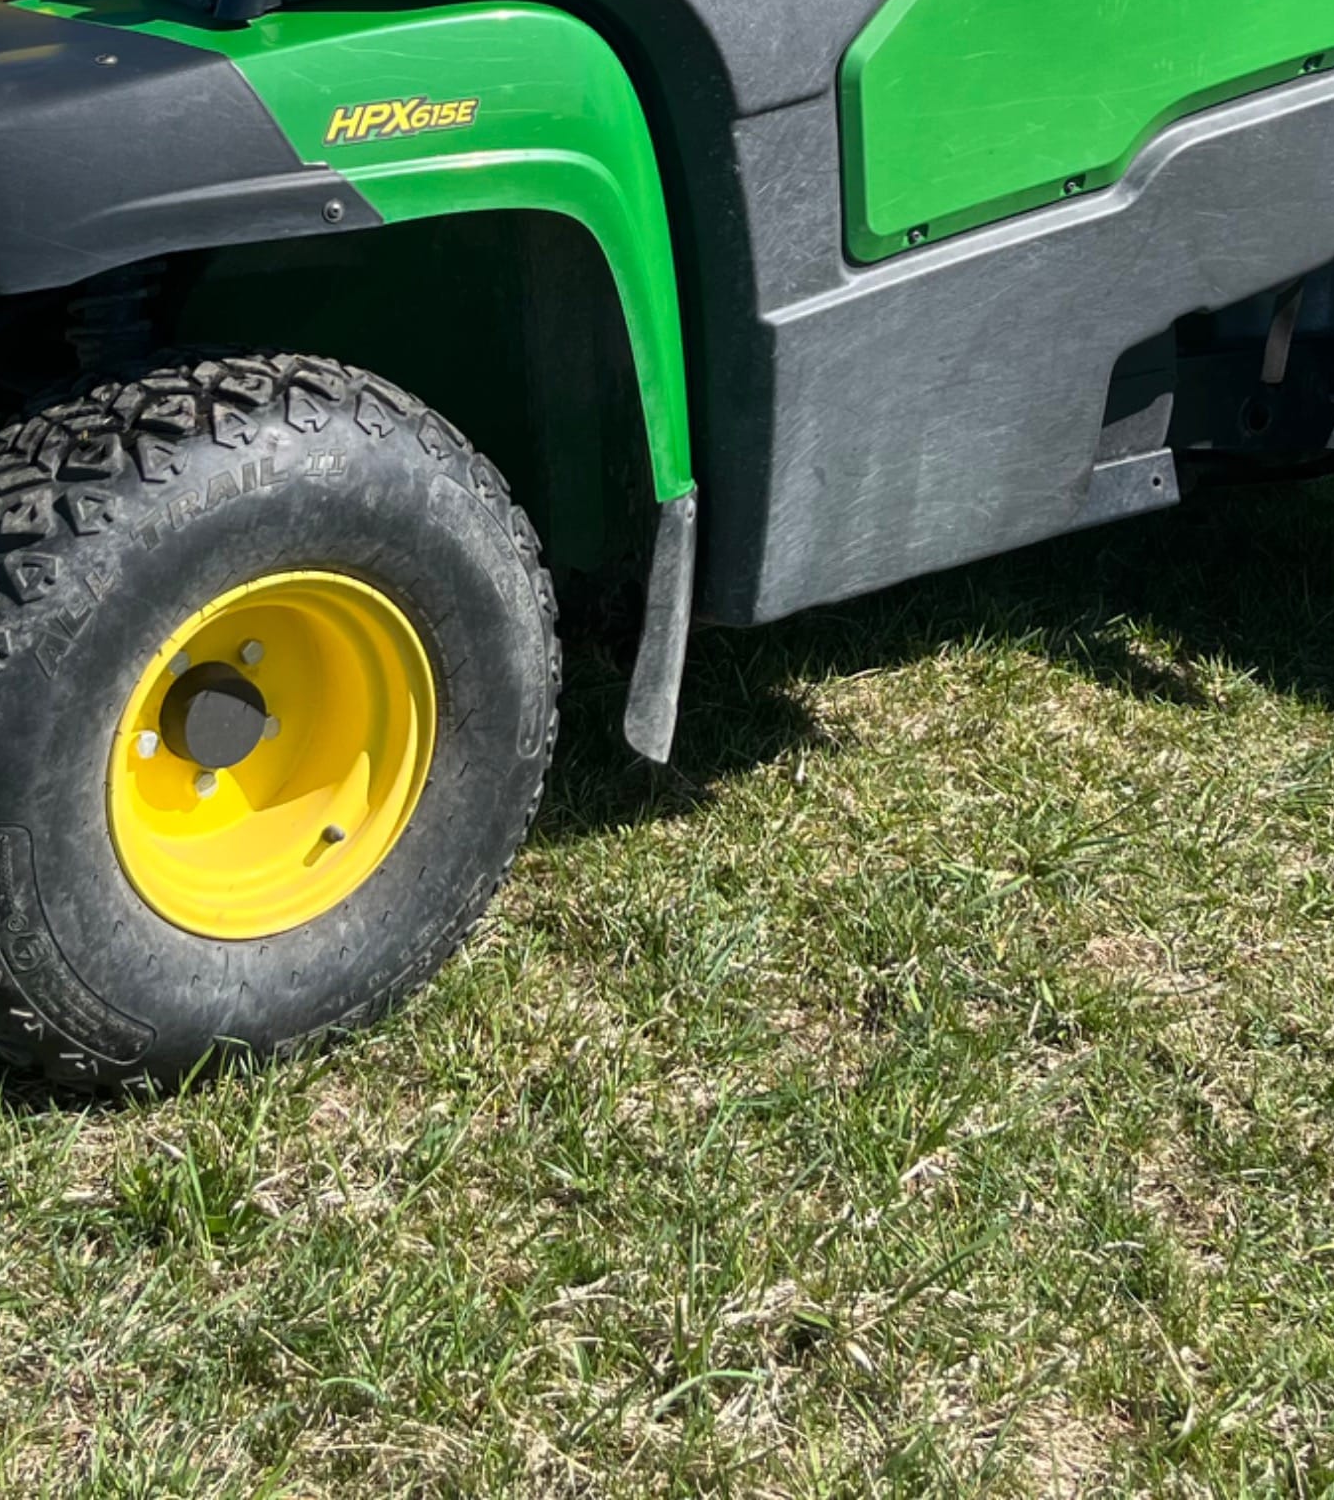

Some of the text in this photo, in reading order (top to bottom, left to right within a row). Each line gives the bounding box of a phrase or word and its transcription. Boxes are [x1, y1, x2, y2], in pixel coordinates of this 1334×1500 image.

[34, 449, 347, 679] ALL TRAIL II
